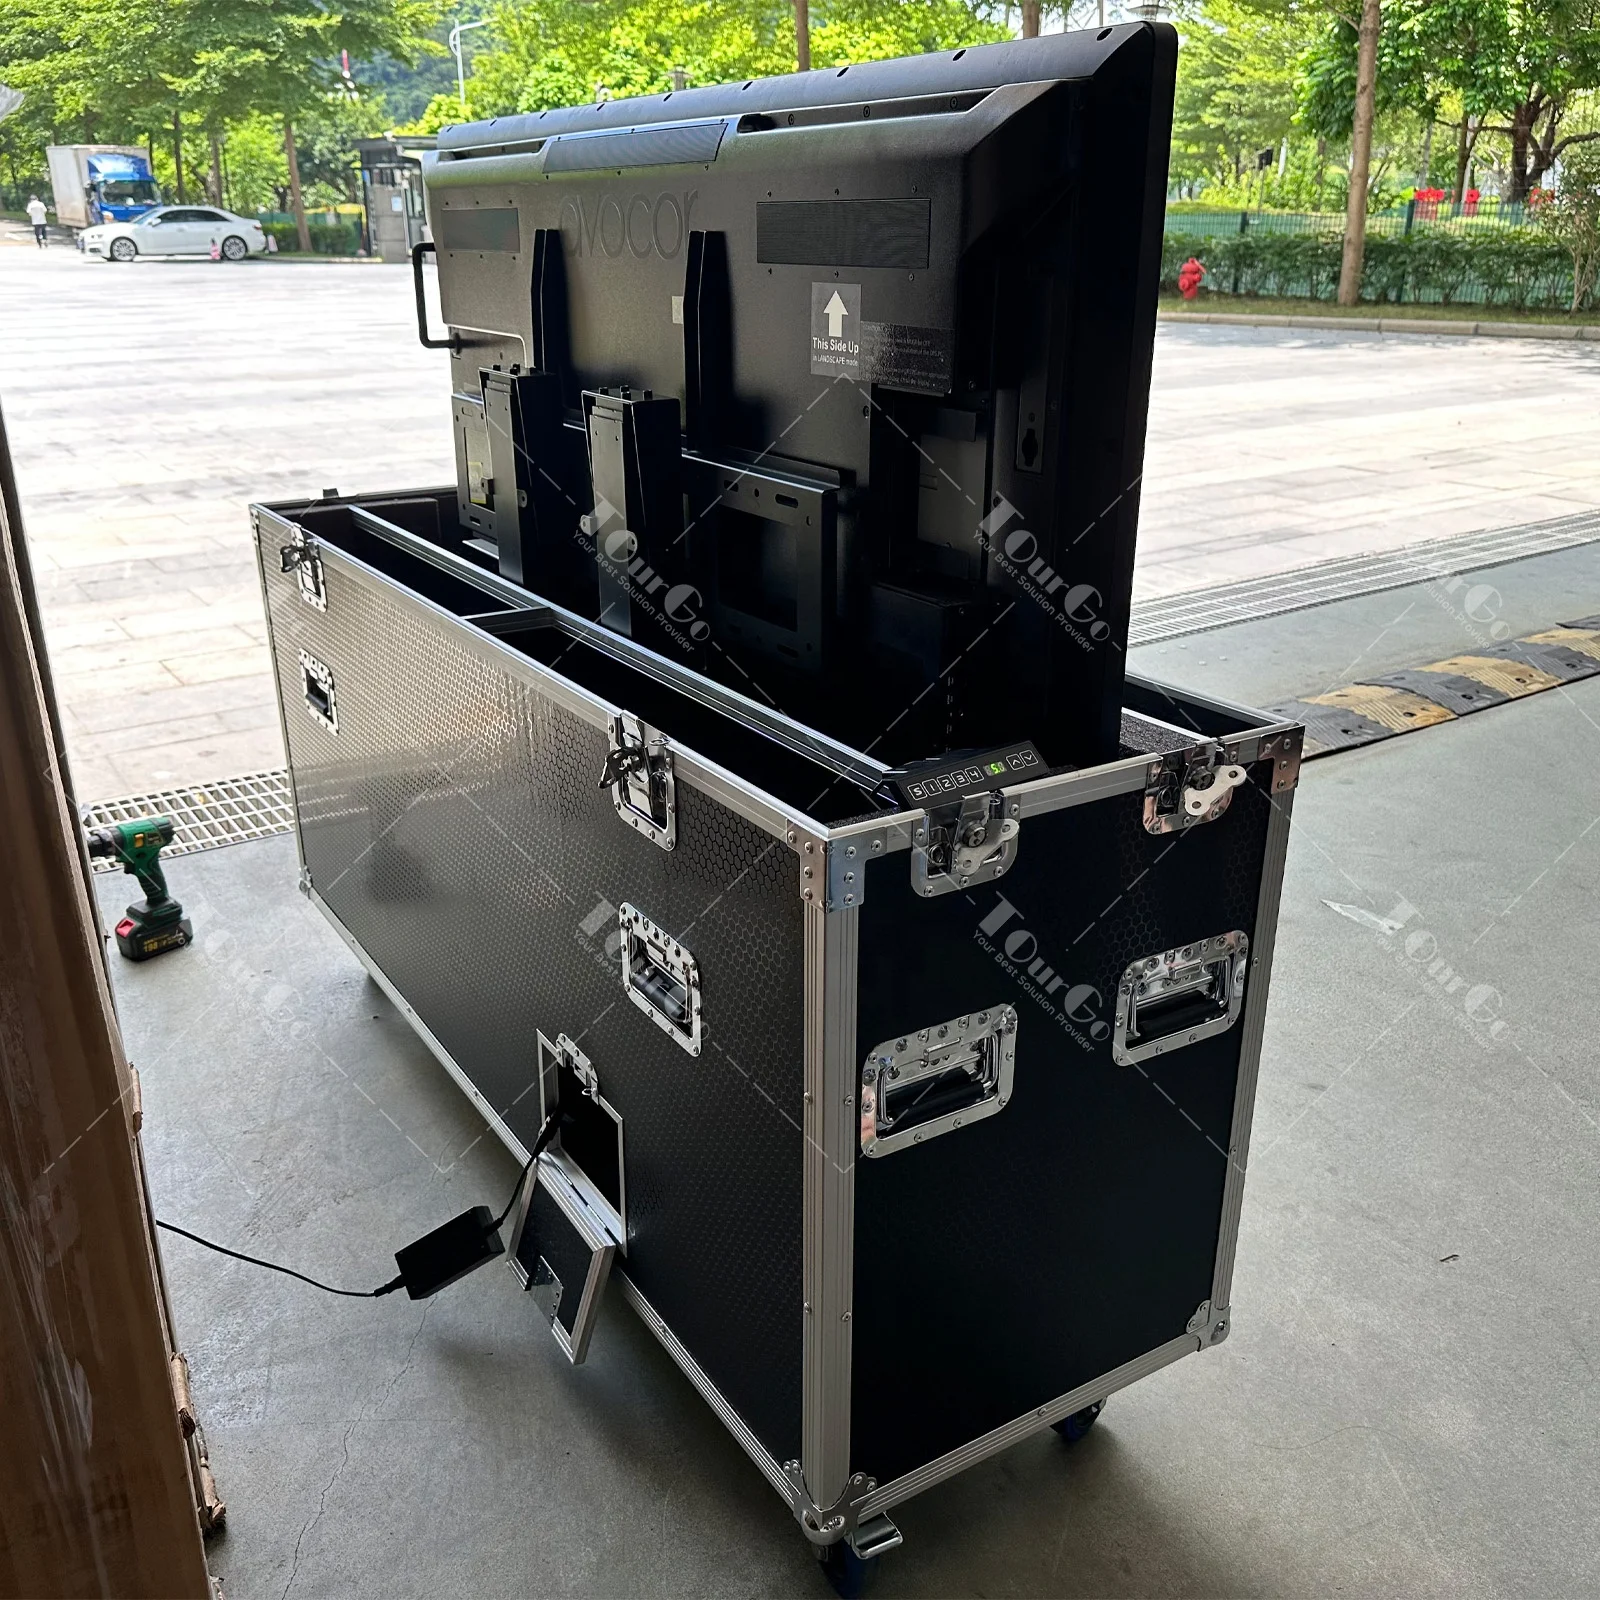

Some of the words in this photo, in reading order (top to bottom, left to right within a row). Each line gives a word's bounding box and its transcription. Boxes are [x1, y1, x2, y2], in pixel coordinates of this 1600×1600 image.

[560, 189, 698, 260] avocor
[813, 337, 829, 350] This
[830, 339, 847, 352] Side
[848, 341, 859, 355] Up
[818, 355, 845, 365] LANDSCAPE
[941, 779, 952, 788] 2
[956, 774, 965, 783] 3
[969, 770, 979, 778] 4
